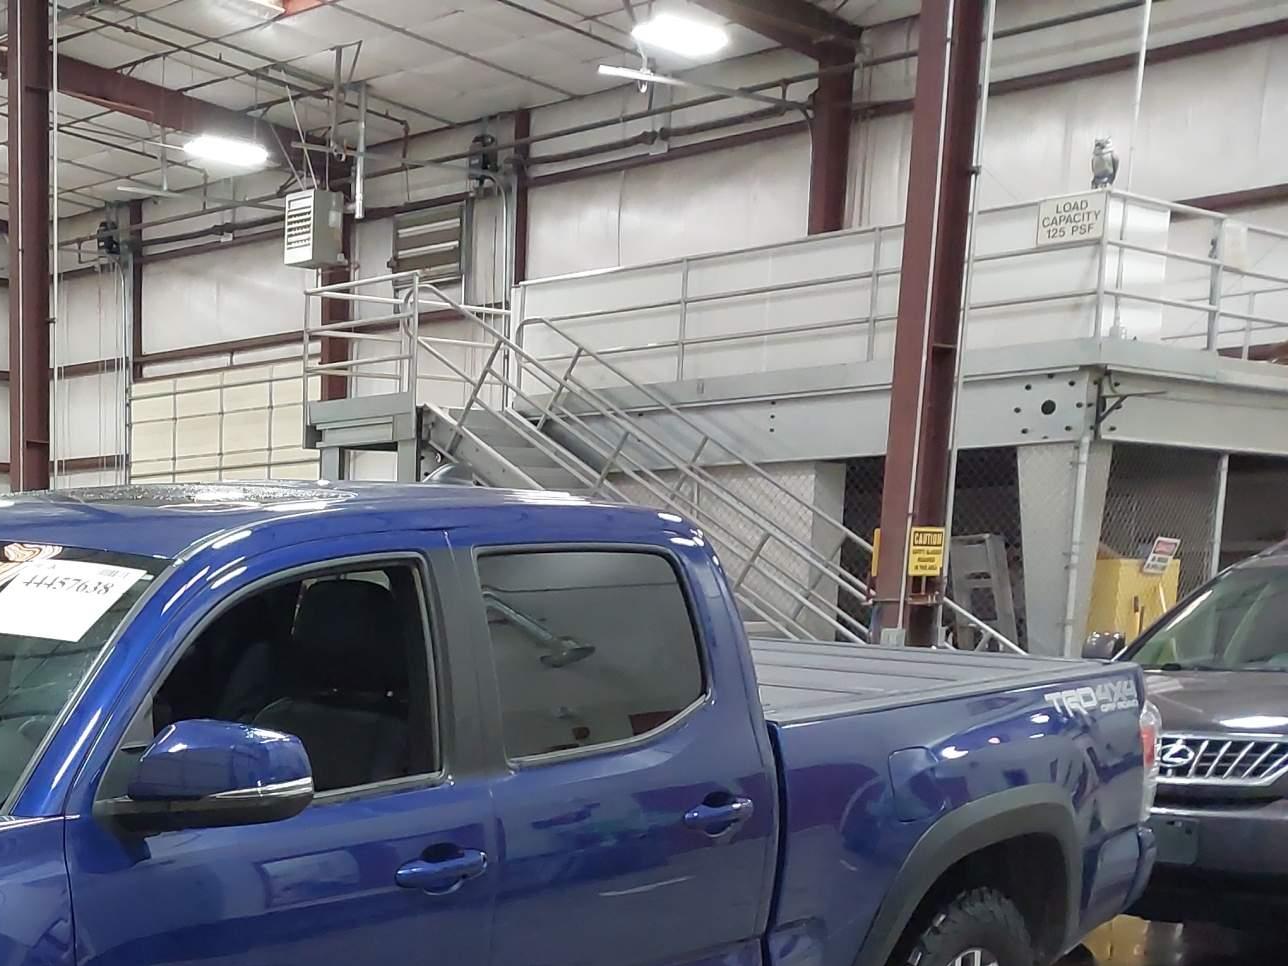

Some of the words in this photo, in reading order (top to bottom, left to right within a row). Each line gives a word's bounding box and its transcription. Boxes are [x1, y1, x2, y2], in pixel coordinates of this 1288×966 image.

[1056, 199, 1089, 215] LOAD
[1041, 209, 1101, 229] CAPACITY
[1046, 226, 1066, 240] 125
[1071, 223, 1095, 236] PSF
[914, 532, 943, 546] CAUTION
[23, 574, 114, 595] 44457638
[1044, 686, 1098, 718] TRD
